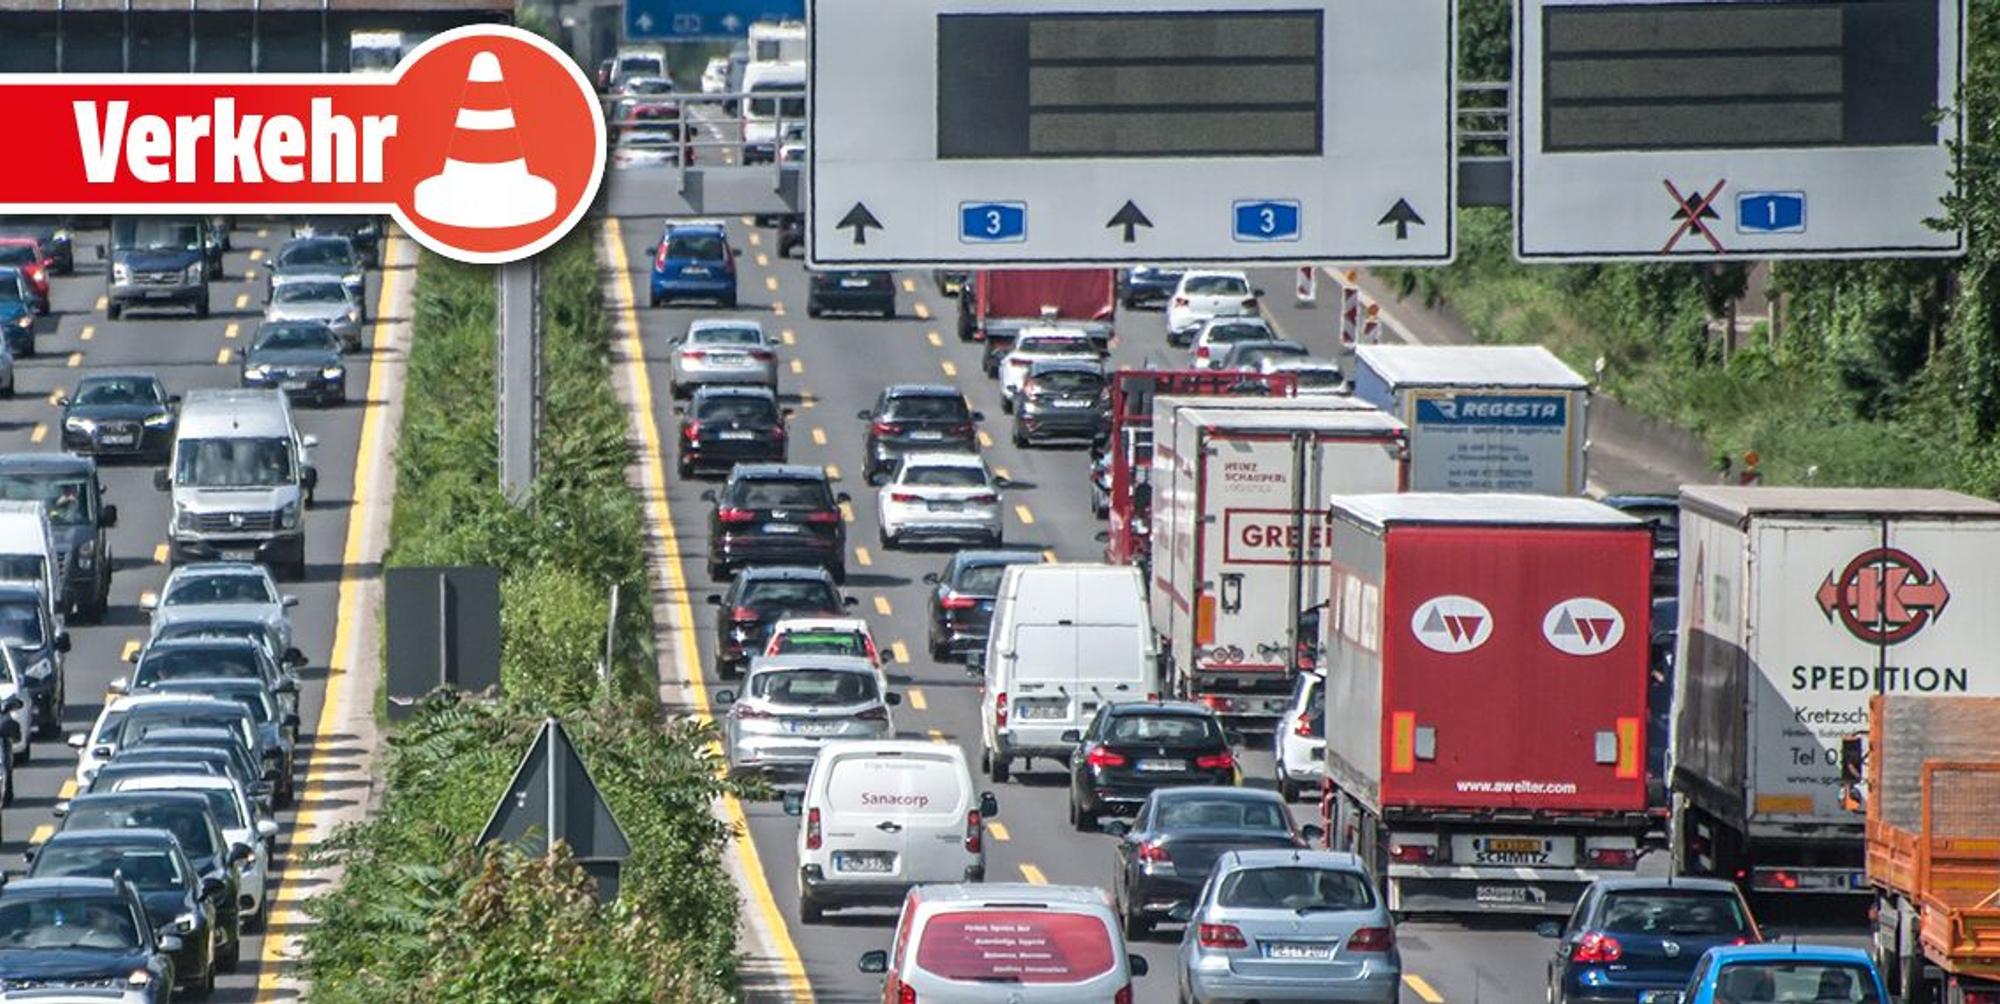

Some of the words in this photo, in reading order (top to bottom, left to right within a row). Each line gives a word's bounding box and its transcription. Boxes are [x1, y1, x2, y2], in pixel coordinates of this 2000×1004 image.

[986, 211, 1001, 234] 3
[1260, 208, 1275, 233] 3
[1767, 201, 1776, 225] 1
[1462, 403, 1558, 418] REGESTA
[1242, 525, 1332, 548] GREE
[1791, 665, 1967, 692] SPEDITION
[1790, 747, 1815, 766] Tel
[861, 792, 929, 808] Sanacorp
[1476, 851, 1550, 864] SCHMITZ
